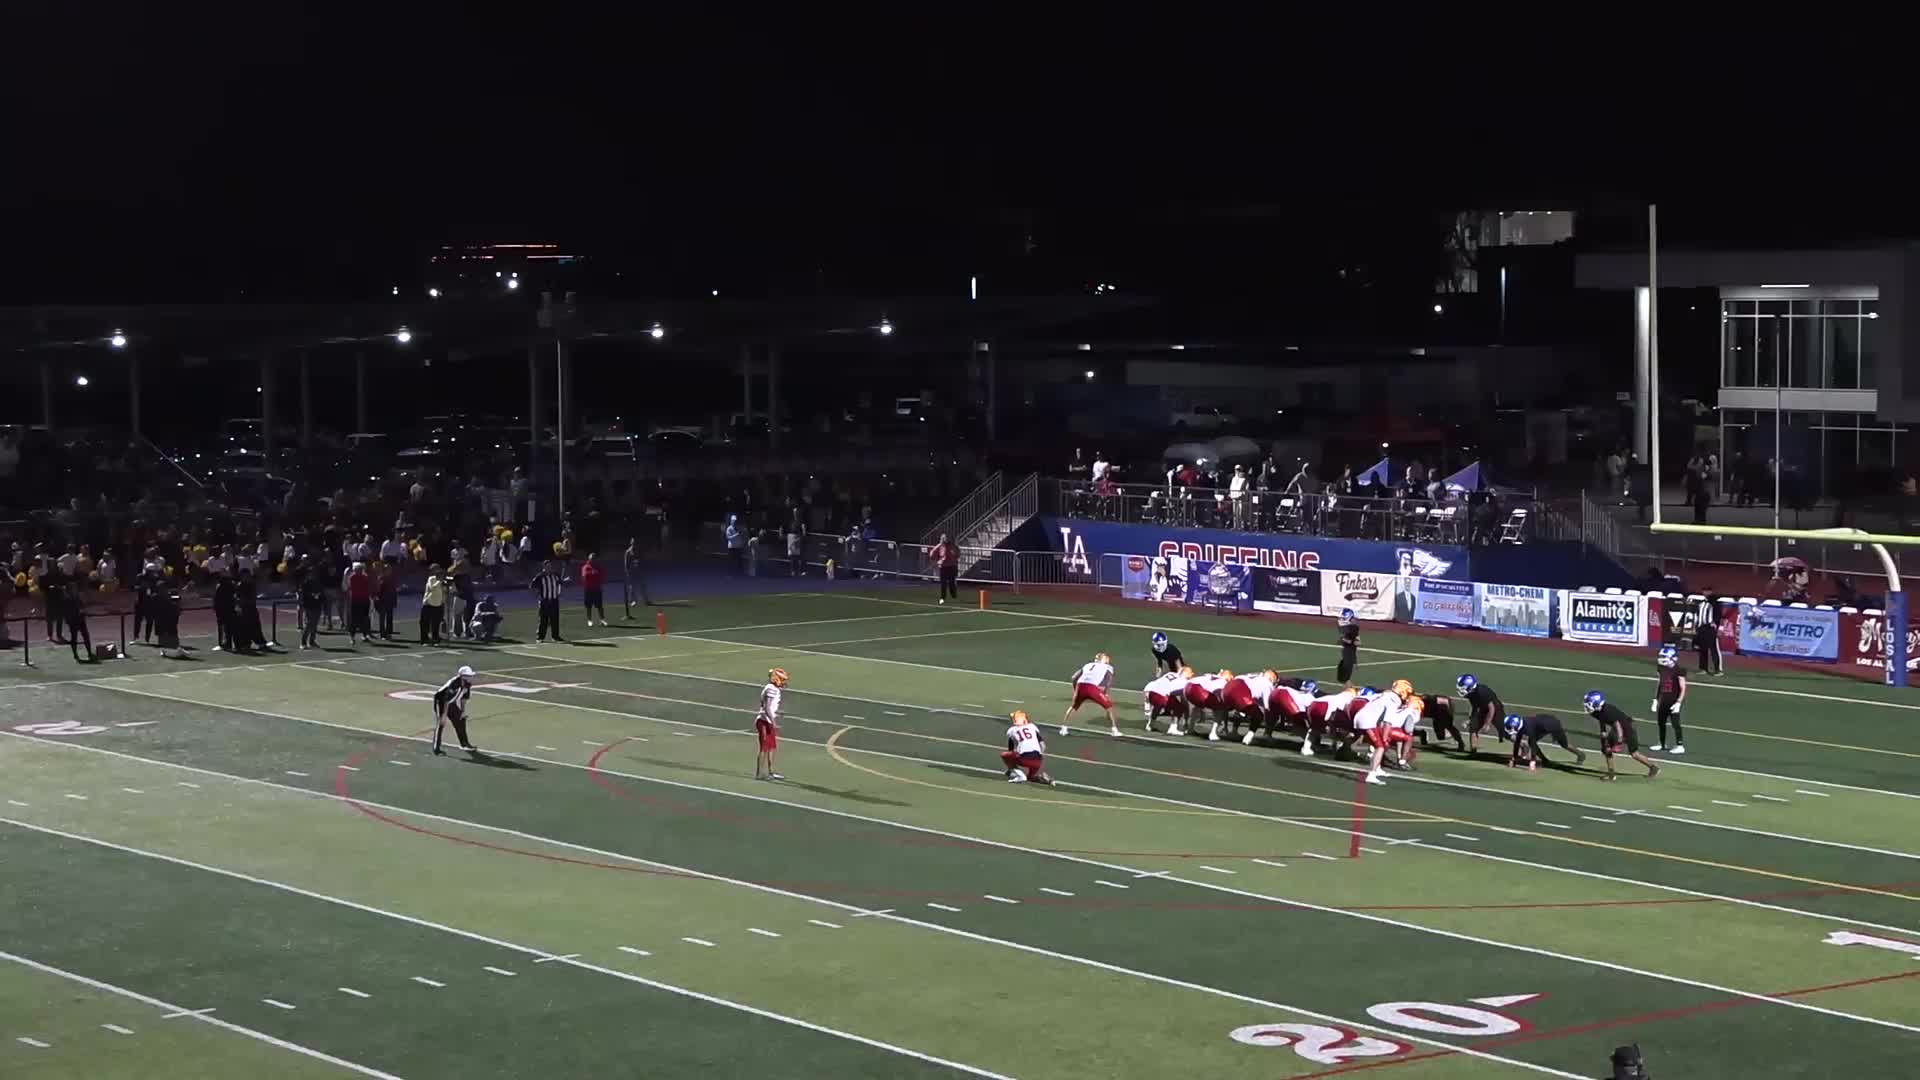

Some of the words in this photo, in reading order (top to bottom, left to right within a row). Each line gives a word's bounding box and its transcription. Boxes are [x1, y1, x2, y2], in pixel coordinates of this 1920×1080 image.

[1335, 572, 1378, 592] Finbars
[1487, 585, 1544, 600] METRO-CHEM
[1575, 600, 1633, 620] Alamitos
[1576, 622, 1631, 633] EYECARE
[1776, 623, 1825, 639] METRO
[1886, 619, 1895, 655] LOS
[1886, 659, 1895, 684] AL
[1016, 727, 1033, 741] 16
[1229, 1001, 1524, 1064] 20
